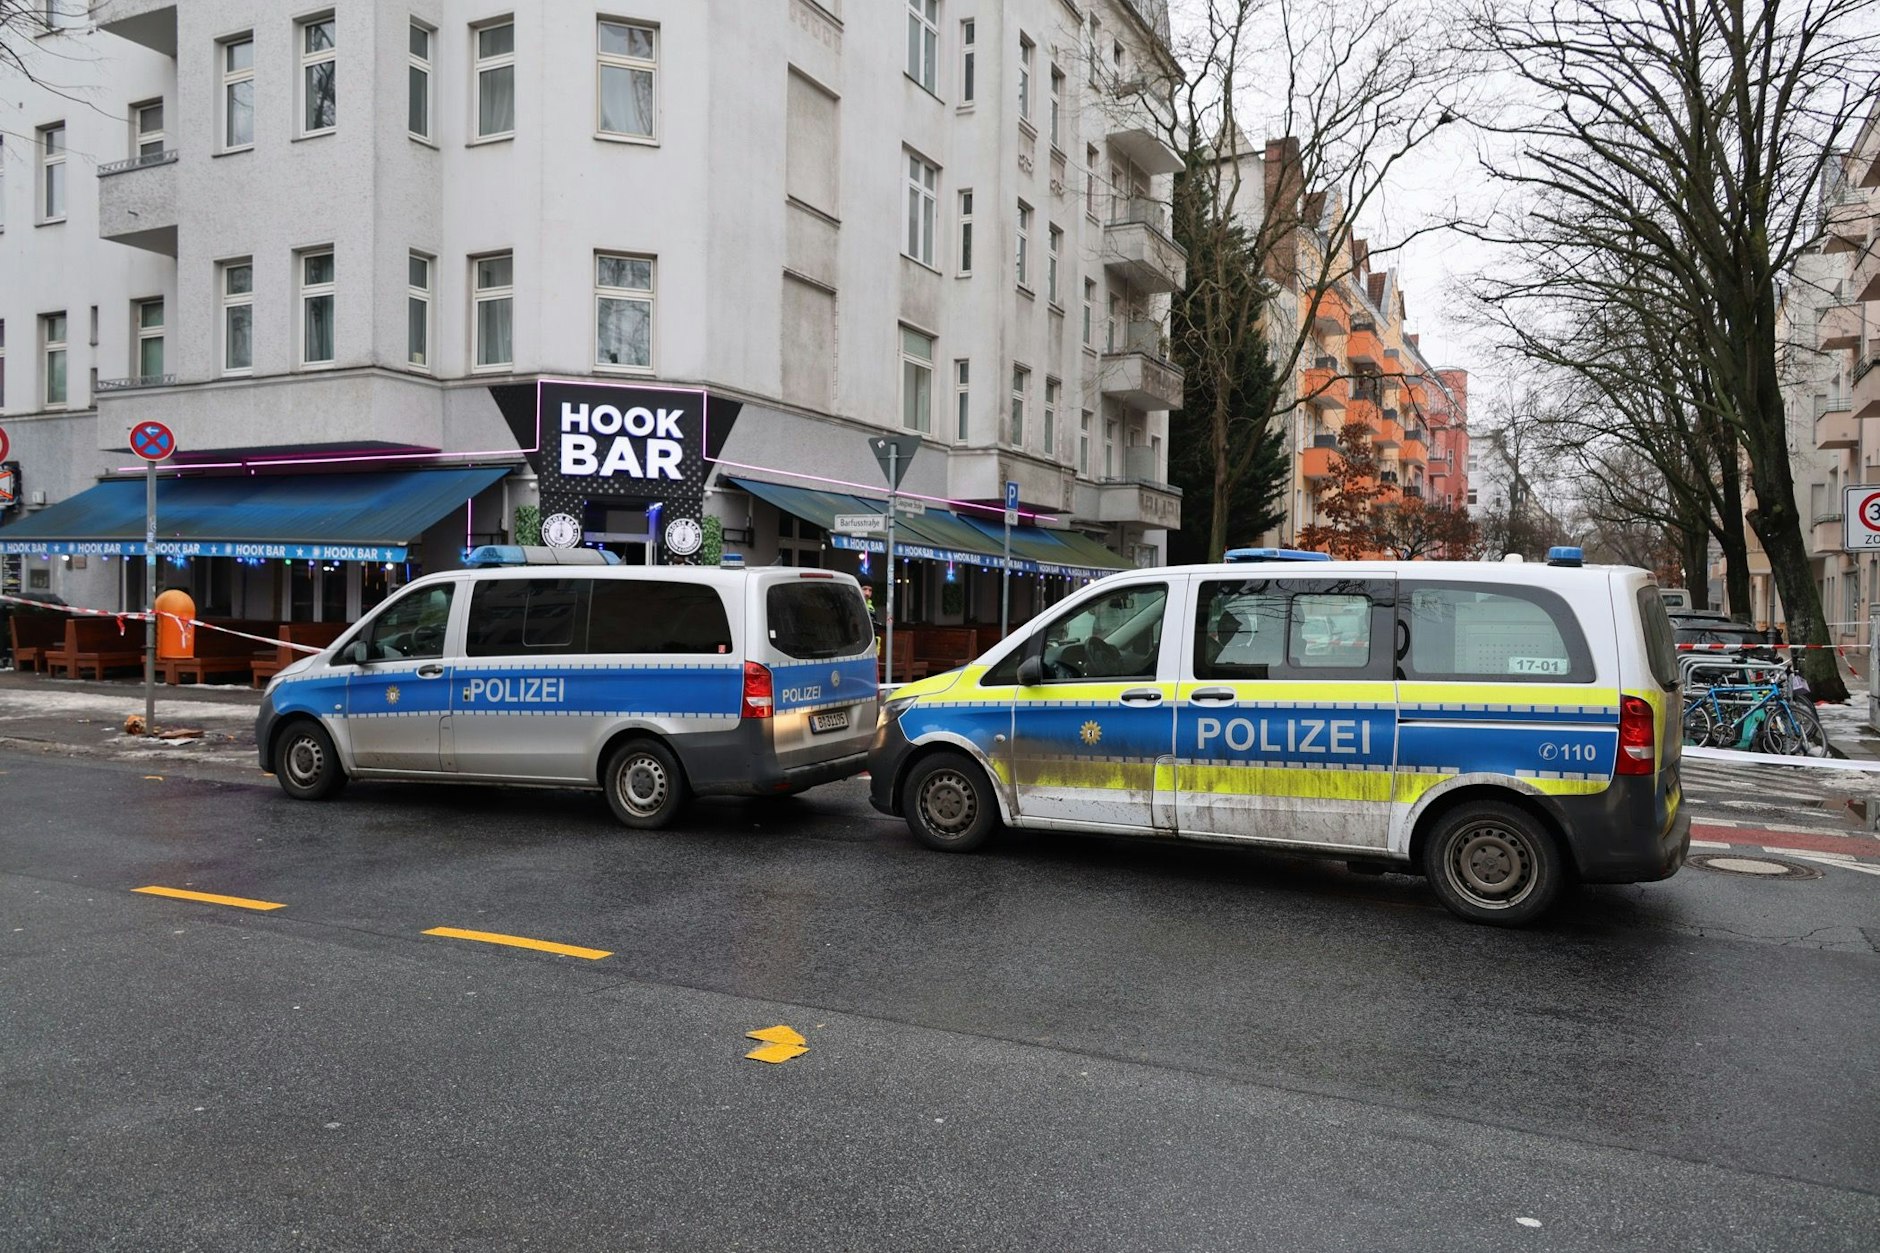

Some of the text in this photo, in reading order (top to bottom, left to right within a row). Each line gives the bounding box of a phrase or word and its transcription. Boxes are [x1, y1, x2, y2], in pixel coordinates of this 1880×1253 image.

[561, 402, 684, 438] HOOK
[560, 433, 684, 480] BAR
[1009, 485, 1016, 506] P
[840, 518, 880, 528] Barfusstraße
[7, 543, 48, 553] HOOK BAR
[78, 543, 121, 553] HOOK BAR
[155, 543, 200, 554] HOOK BAR
[235, 545, 286, 557] HOOK BAR
[850, 538, 885, 552] HOOK BAR
[904, 545, 934, 557] HOOK BAR
[324, 547, 378, 559] HOOK BAR
[953, 552, 981, 564] HOOK BAR
[1516, 660, 1559, 672] 17-01
[470, 678, 565, 703] POLIZEI
[782, 686, 822, 703] POLIZEI
[1197, 717, 1371, 754] POLIZEI
[1560, 744, 1597, 761] 110
